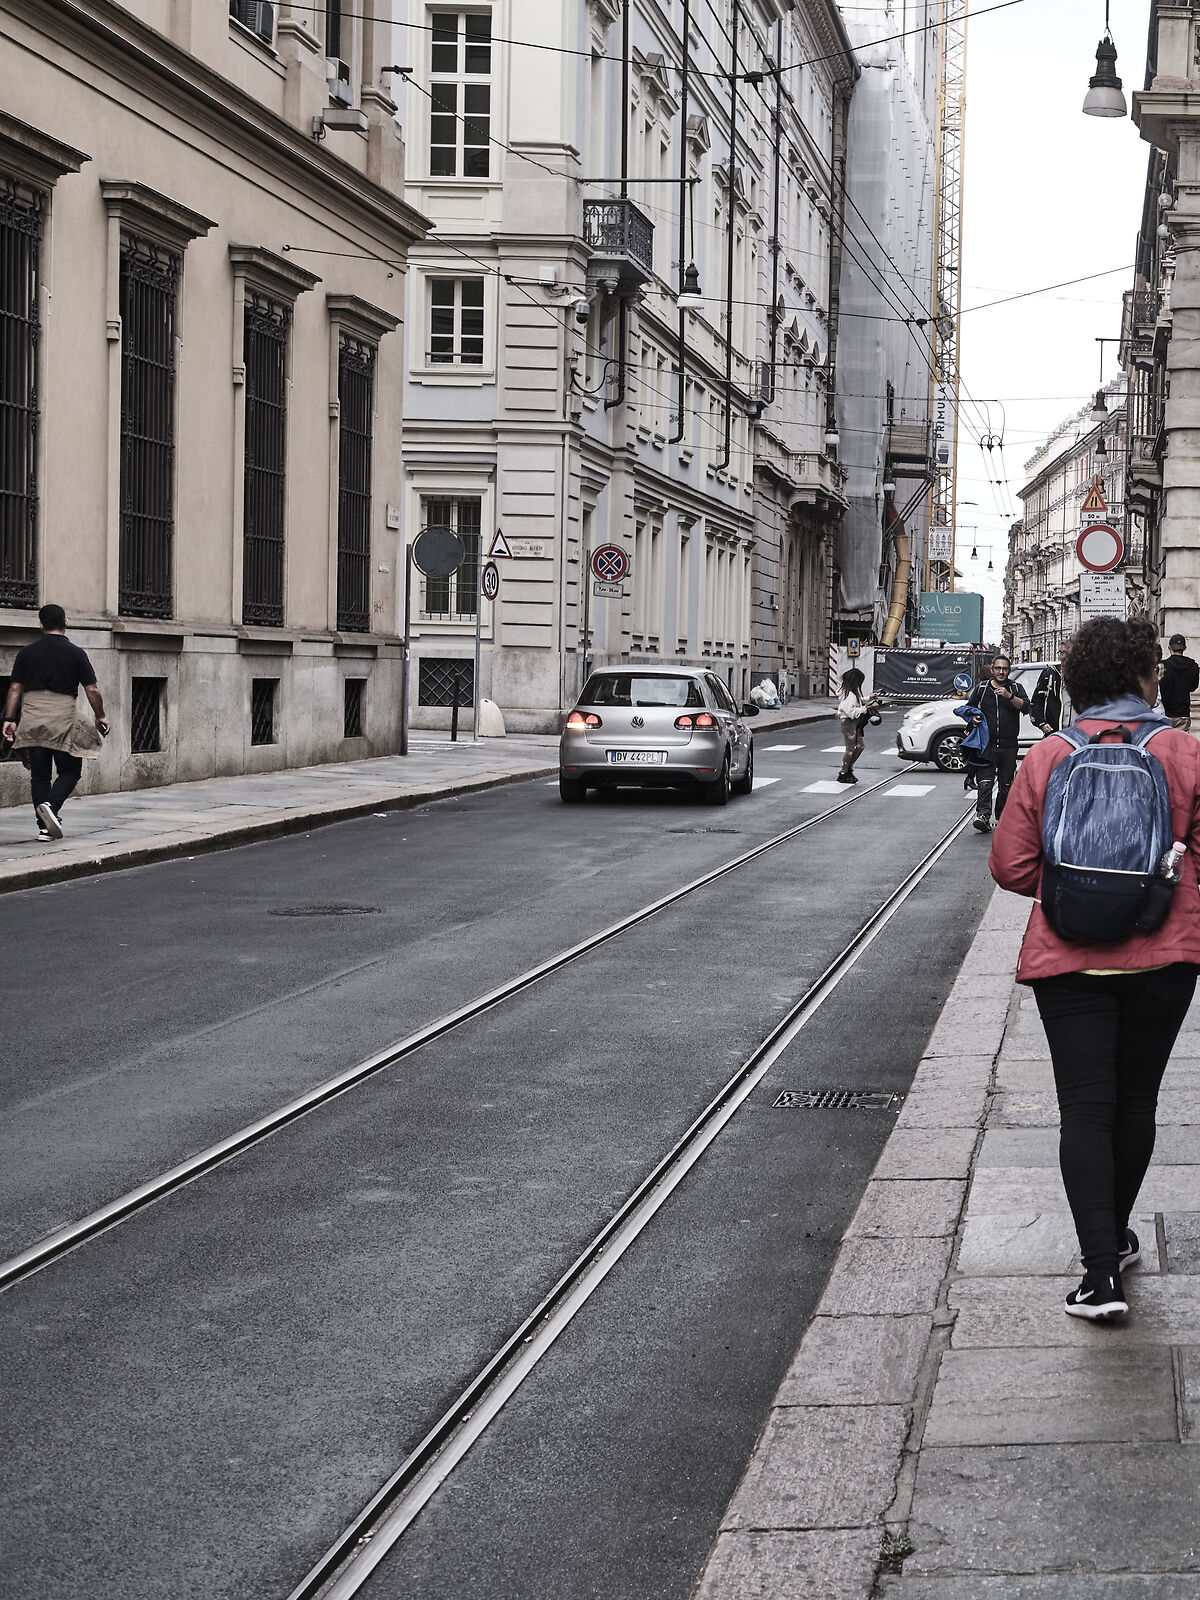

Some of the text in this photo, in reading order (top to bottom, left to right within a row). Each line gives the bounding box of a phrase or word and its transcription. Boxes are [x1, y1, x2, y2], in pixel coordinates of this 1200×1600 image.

[936, 387, 946, 439] PRIMULA
[486, 571, 496, 590] 30
[920, 605, 937, 614] ASA
[616, 752, 628, 761] DV
